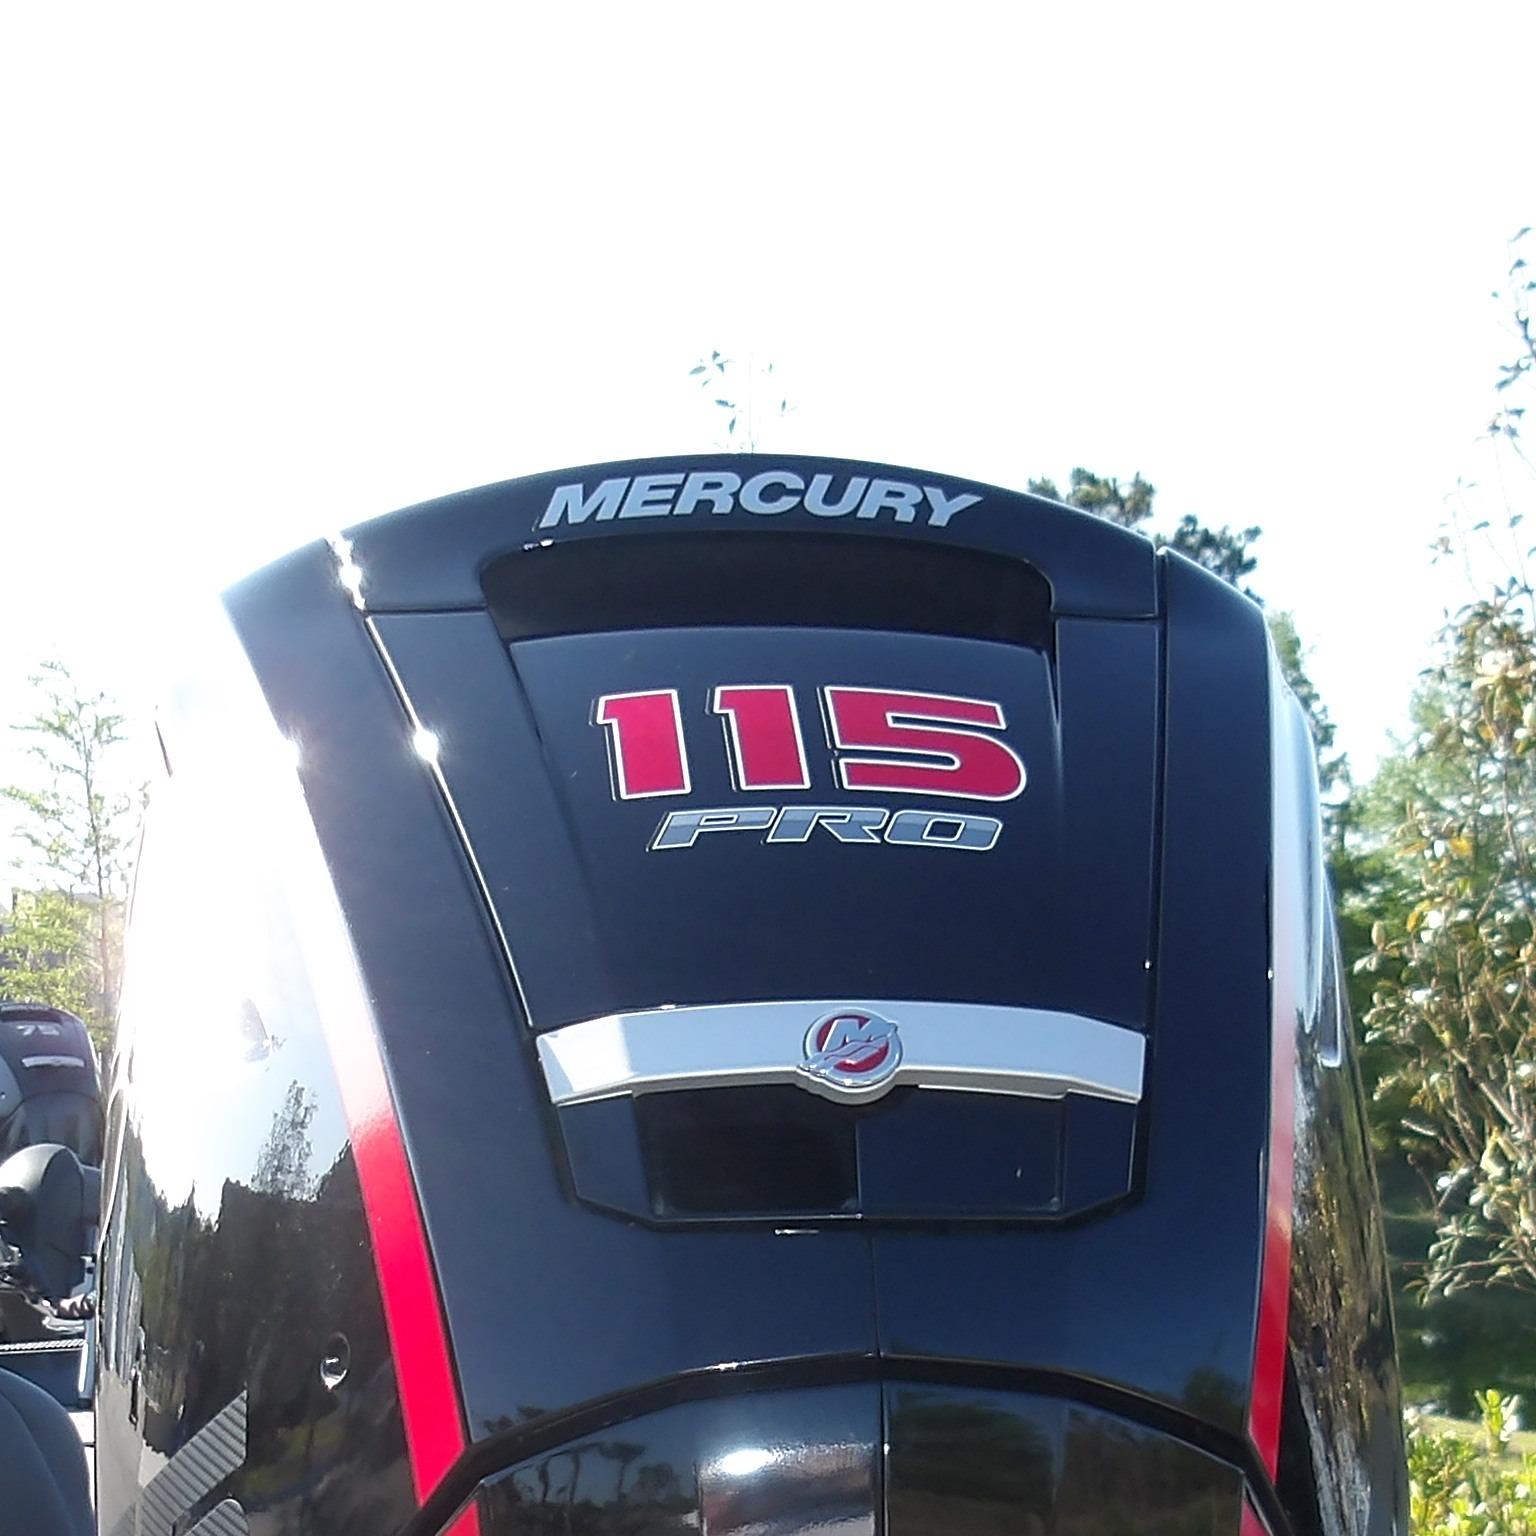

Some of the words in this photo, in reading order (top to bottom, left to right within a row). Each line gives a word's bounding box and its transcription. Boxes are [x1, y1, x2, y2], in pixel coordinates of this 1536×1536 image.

[531, 471, 985, 532] MERCURY
[589, 684, 1028, 804] 115
[646, 806, 1004, 852] PRO
